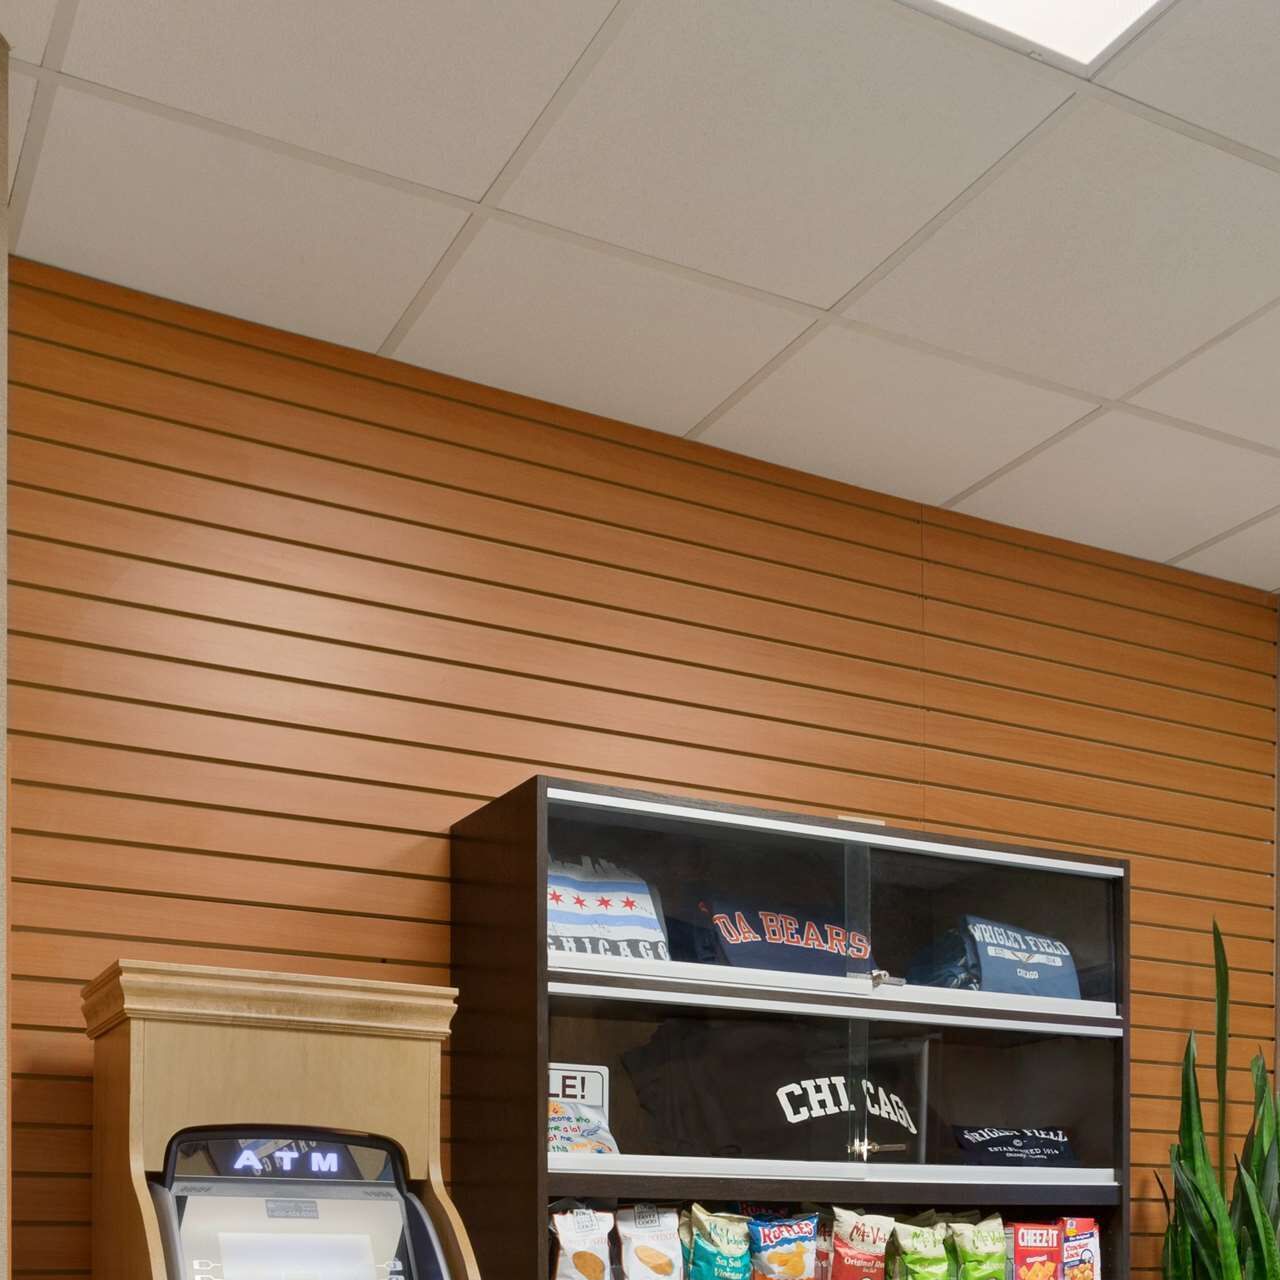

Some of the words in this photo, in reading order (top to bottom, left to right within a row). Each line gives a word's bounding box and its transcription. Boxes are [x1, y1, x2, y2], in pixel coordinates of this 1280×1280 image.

[761, 912, 871, 958] BEARS
[968, 923, 1027, 949] WRIGLEY
[1025, 936, 1070, 955] FIELD
[234, 1150, 338, 1172] ATM
[760, 1221, 814, 1247] RUFFLES
[1018, 1228, 1059, 1247] CHEEZ-IT
